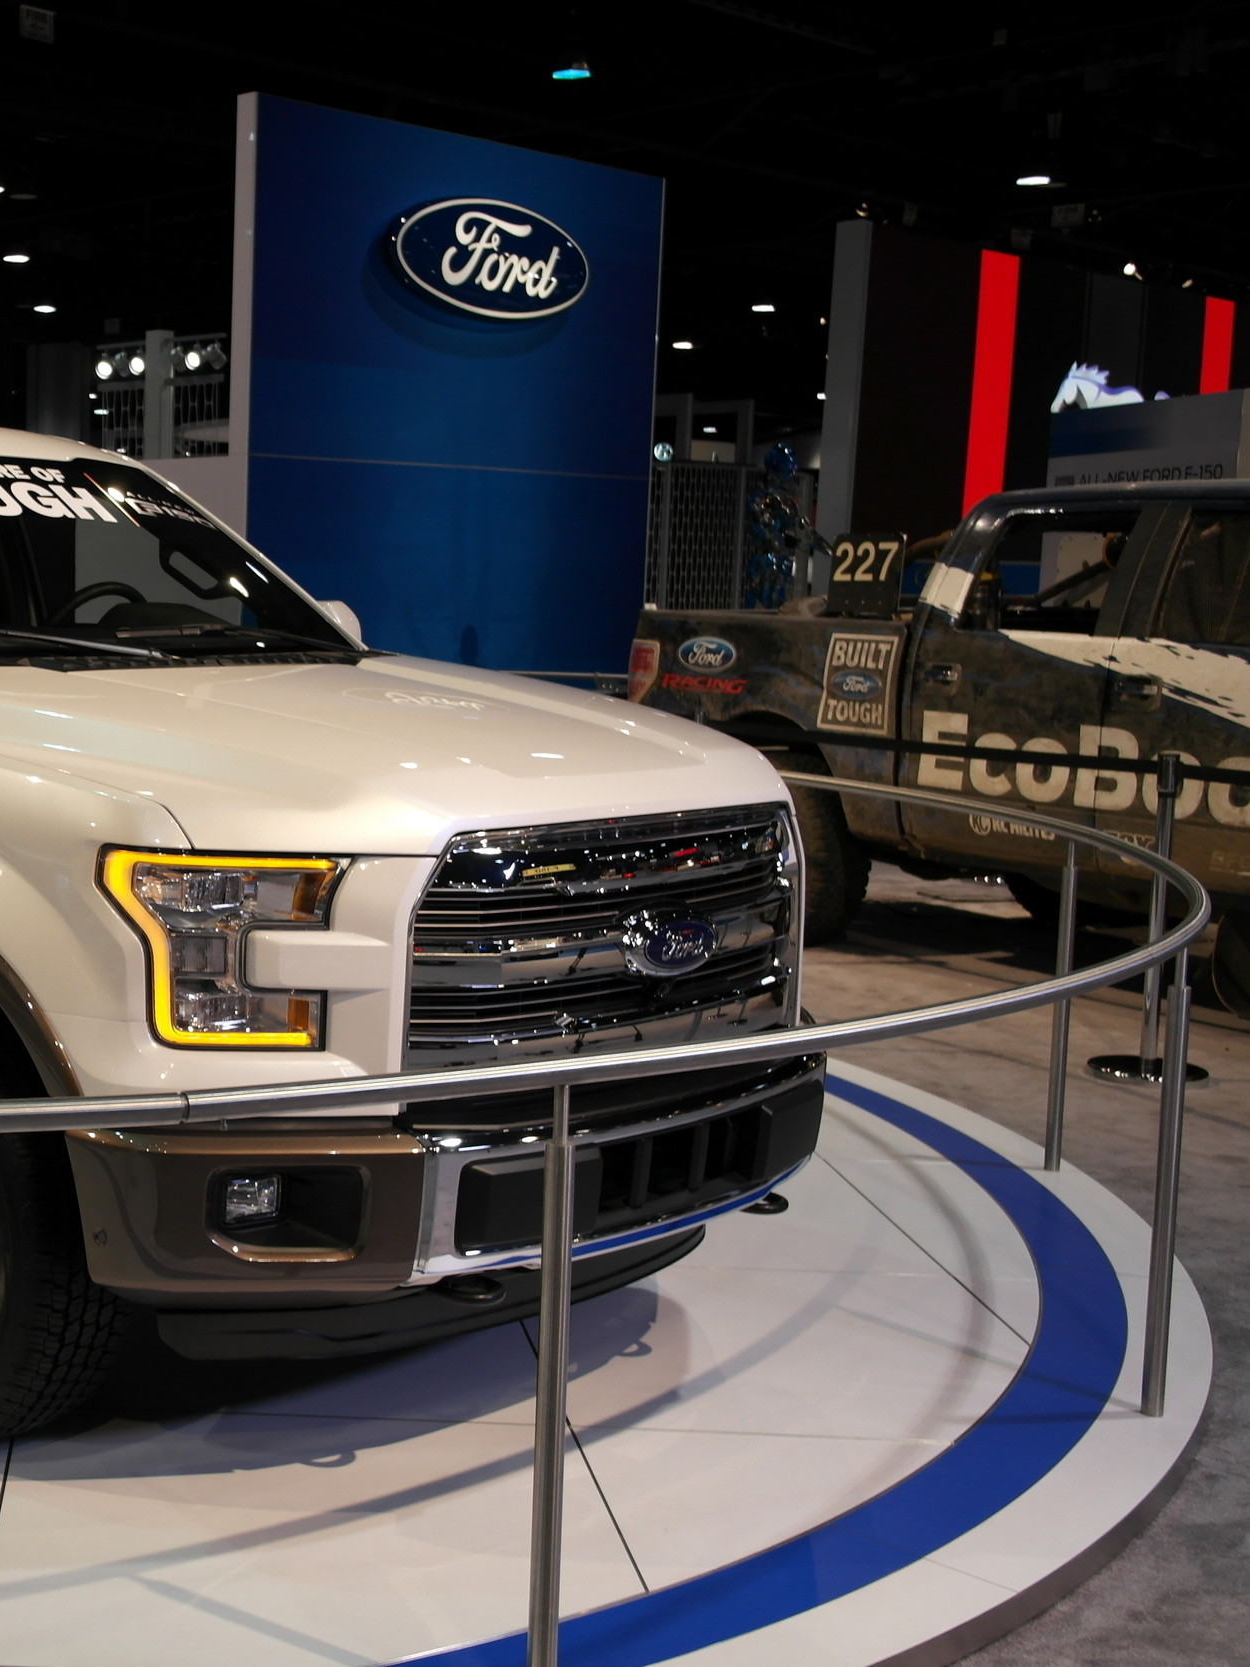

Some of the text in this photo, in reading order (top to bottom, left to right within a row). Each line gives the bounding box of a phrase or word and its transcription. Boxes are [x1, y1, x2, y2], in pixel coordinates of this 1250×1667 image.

[441, 211, 560, 299] Ford
[30, 467, 66, 483] OF
[1142, 466, 1182, 482] FORD
[1184, 464, 1223, 480] F-150
[833, 541, 899, 582] 227
[688, 641, 726, 667] Ford
[831, 641, 892, 670] BUILT
[660, 673, 749, 695] RACING
[842, 675, 871, 693] Ford
[827, 699, 883, 726] TOUGH
[661, 929, 706, 961] Ford
